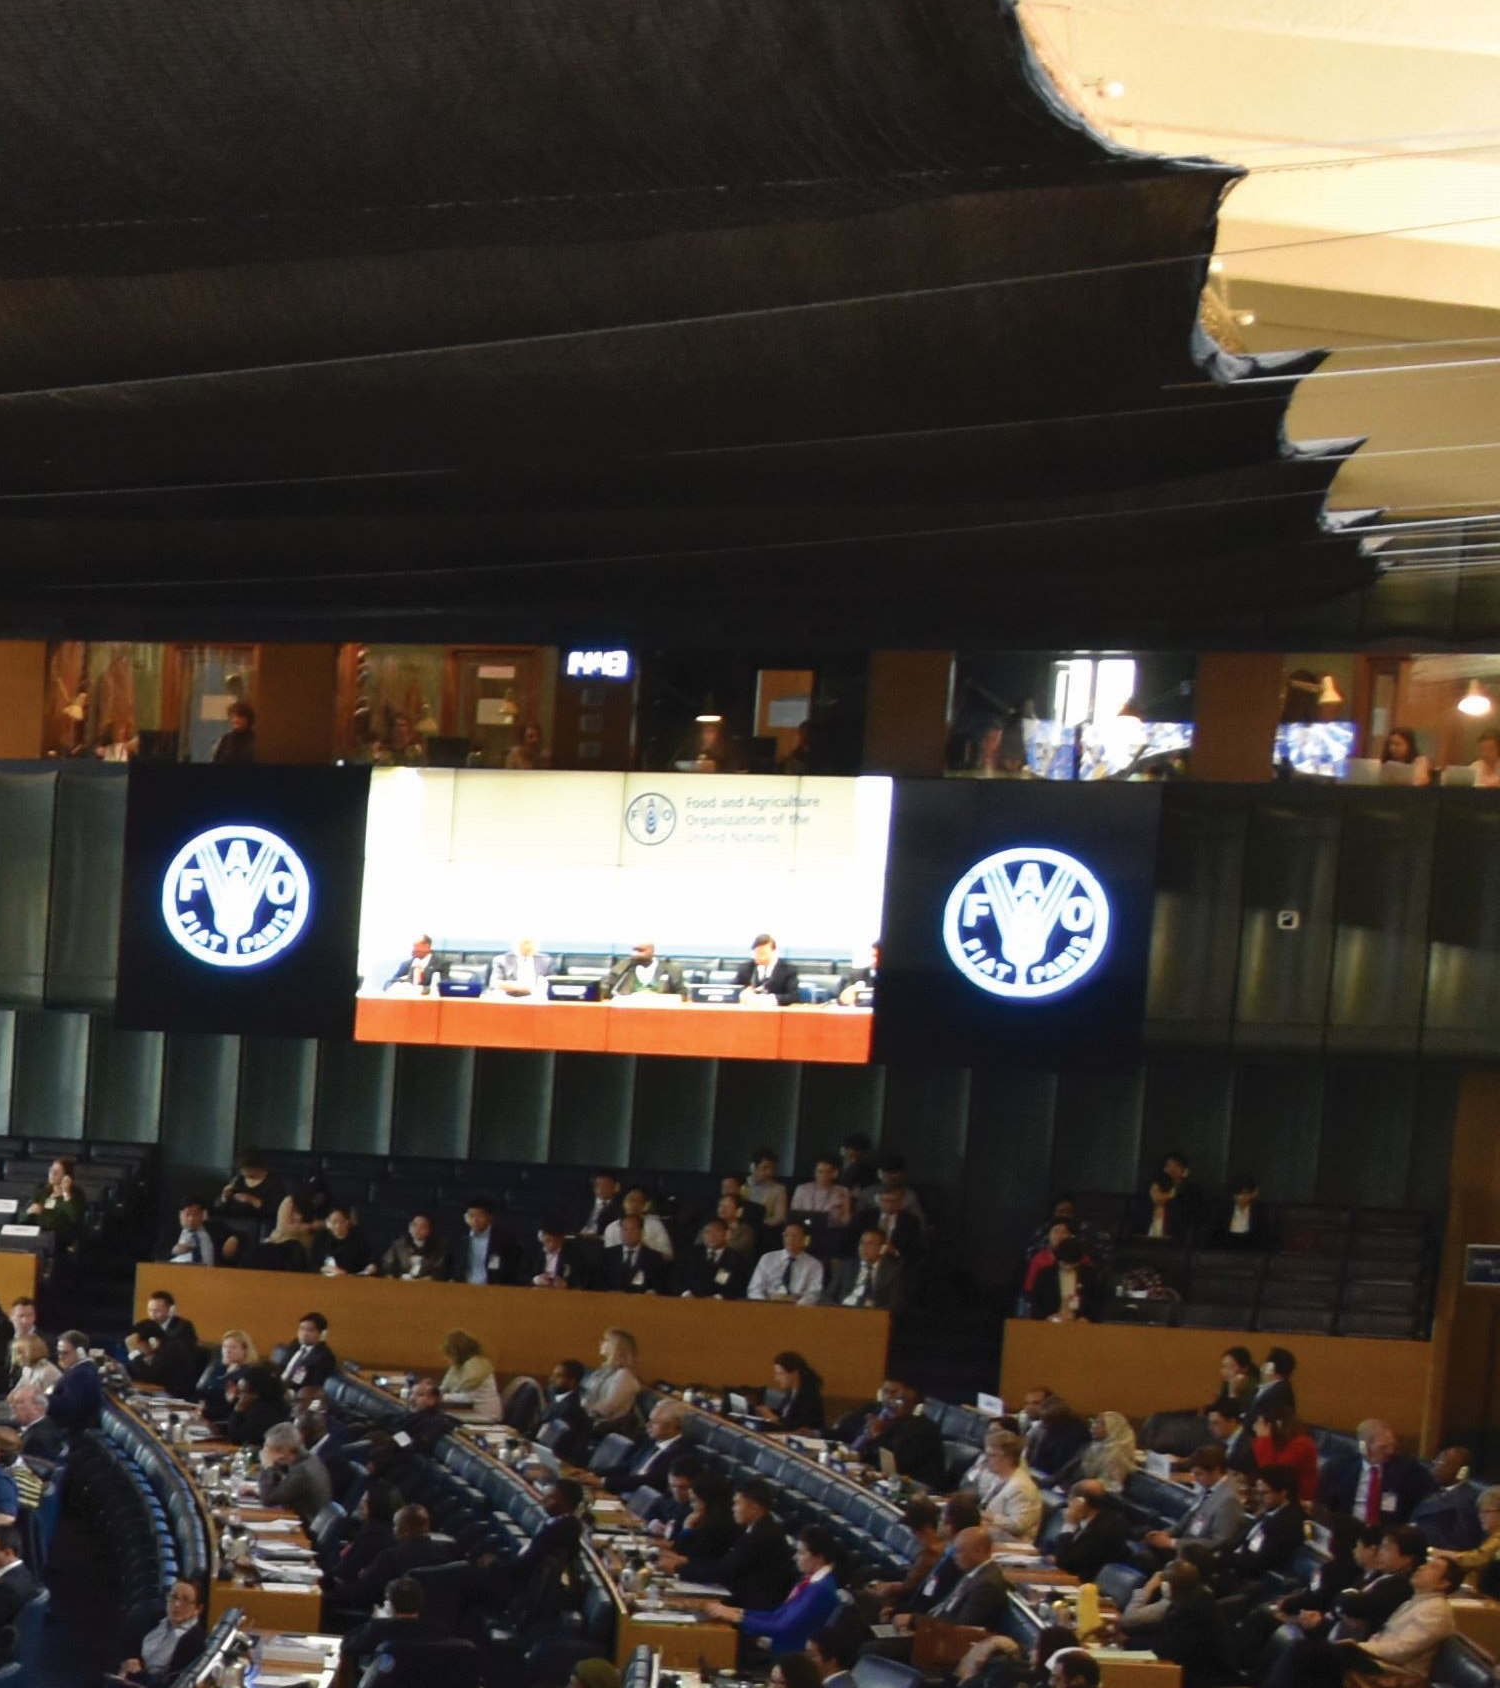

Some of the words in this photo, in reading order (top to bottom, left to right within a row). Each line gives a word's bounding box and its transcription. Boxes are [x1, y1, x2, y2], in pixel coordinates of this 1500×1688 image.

[685, 797, 715, 808] Food
[721, 797, 744, 808] and
[747, 797, 820, 811] Agriculture
[685, 814, 766, 828] Organization
[771, 813, 784, 825] of
[178, 839, 297, 905] FAO
[962, 862, 1094, 932] FAO
[179, 911, 224, 951] FIAT
[240, 908, 293, 953] PANIS
[963, 938, 1012, 980] FIAT
[1030, 936, 1090, 983] PANIS
